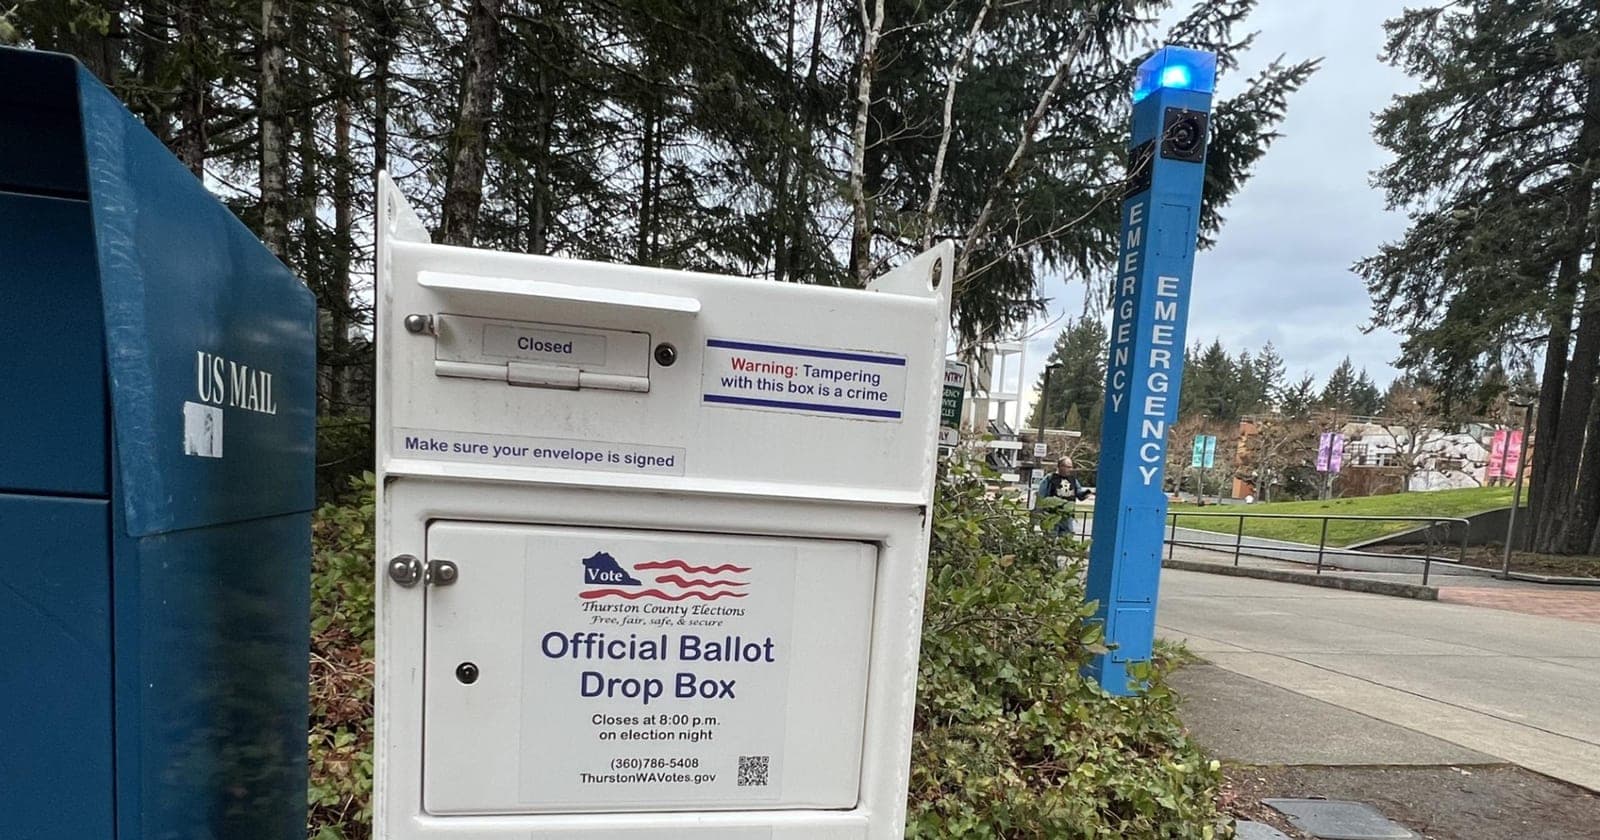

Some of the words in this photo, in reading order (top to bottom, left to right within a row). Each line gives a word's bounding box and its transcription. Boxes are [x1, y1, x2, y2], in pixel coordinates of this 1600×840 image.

[1112, 202, 1144, 413] EMERGENCY
[517, 336, 573, 354] Closed
[197, 350, 225, 404] US
[229, 360, 277, 415] MAIL
[731, 357, 798, 379] Warning:
[803, 364, 881, 387] Tampering
[1139, 276, 1180, 486] EMERGENCY
[720, 375, 753, 390] with
[757, 377, 784, 392] this
[788, 380, 814, 395] box
[818, 383, 830, 397] is
[834, 387, 843, 398] a
[846, 387, 888, 402] crime
[405, 436, 448, 453] Make
[453, 441, 488, 455] sure
[493, 444, 529, 460] your
[533, 445, 604, 465] envelope
[608, 449, 620, 464] is
[624, 451, 675, 468] signed
[587, 568, 623, 582] Vote
[581, 601, 640, 613] Thurston
[643, 603, 688, 617] County
[691, 604, 746, 616] Elections
[589, 615, 619, 626] Free,
[619, 615, 646, 627] fair,
[650, 616, 674, 627] safe,
[676, 618, 685, 626] &
[688, 619, 723, 627] secure
[541, 631, 668, 660] Official
[679, 634, 775, 663] Ballot
[580, 671, 664, 705] Drop
[674, 672, 736, 699] Box
[591, 714, 639, 726] Closes
[643, 715, 656, 726] at
[659, 714, 689, 726] 8:00
[692, 716, 721, 728] p.m.
[599, 731, 616, 740] on
[620, 729, 675, 740] election
[678, 729, 713, 743] night
[610, 758, 699, 770] (360)786-5408
[580, 773, 716, 785] ThurstonWAVotes.gov
